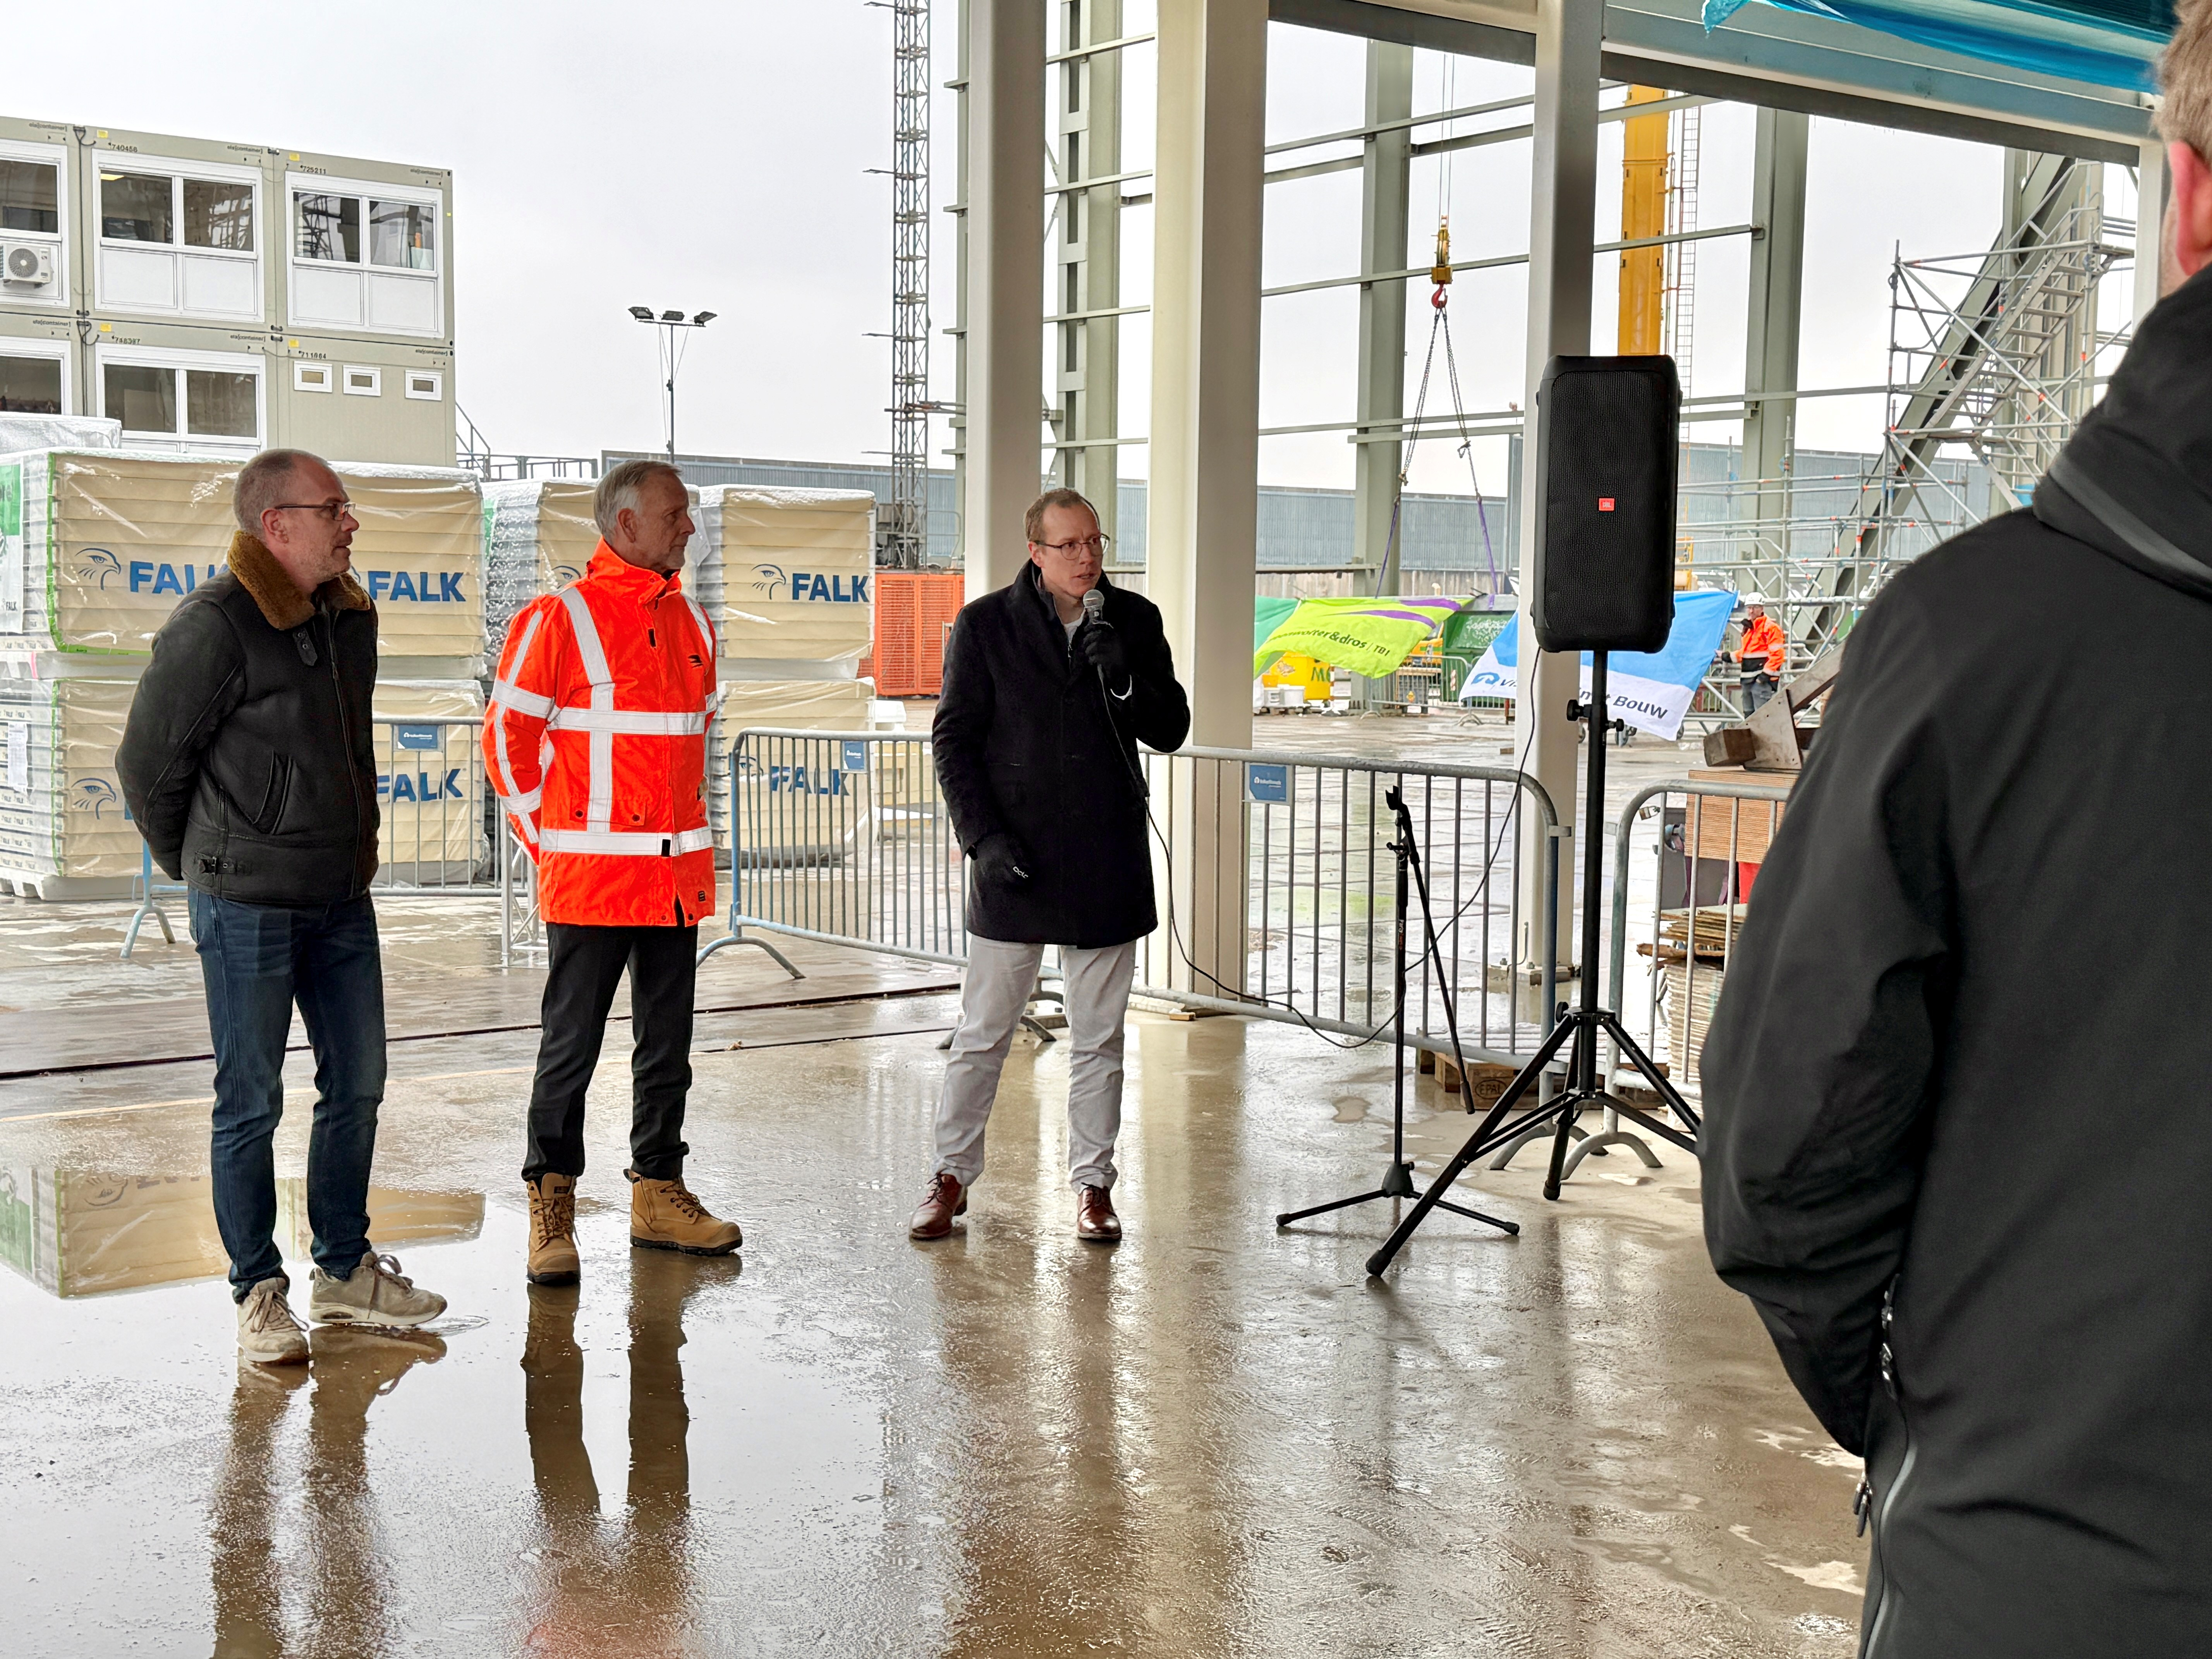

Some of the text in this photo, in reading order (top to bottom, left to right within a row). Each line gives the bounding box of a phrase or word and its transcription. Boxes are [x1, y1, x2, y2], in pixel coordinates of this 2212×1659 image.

[368, 570, 466, 602] FALK
[792, 573, 870, 602] FALK
[6, 601, 17, 611] FALK
[771, 766, 850, 796] FALK
